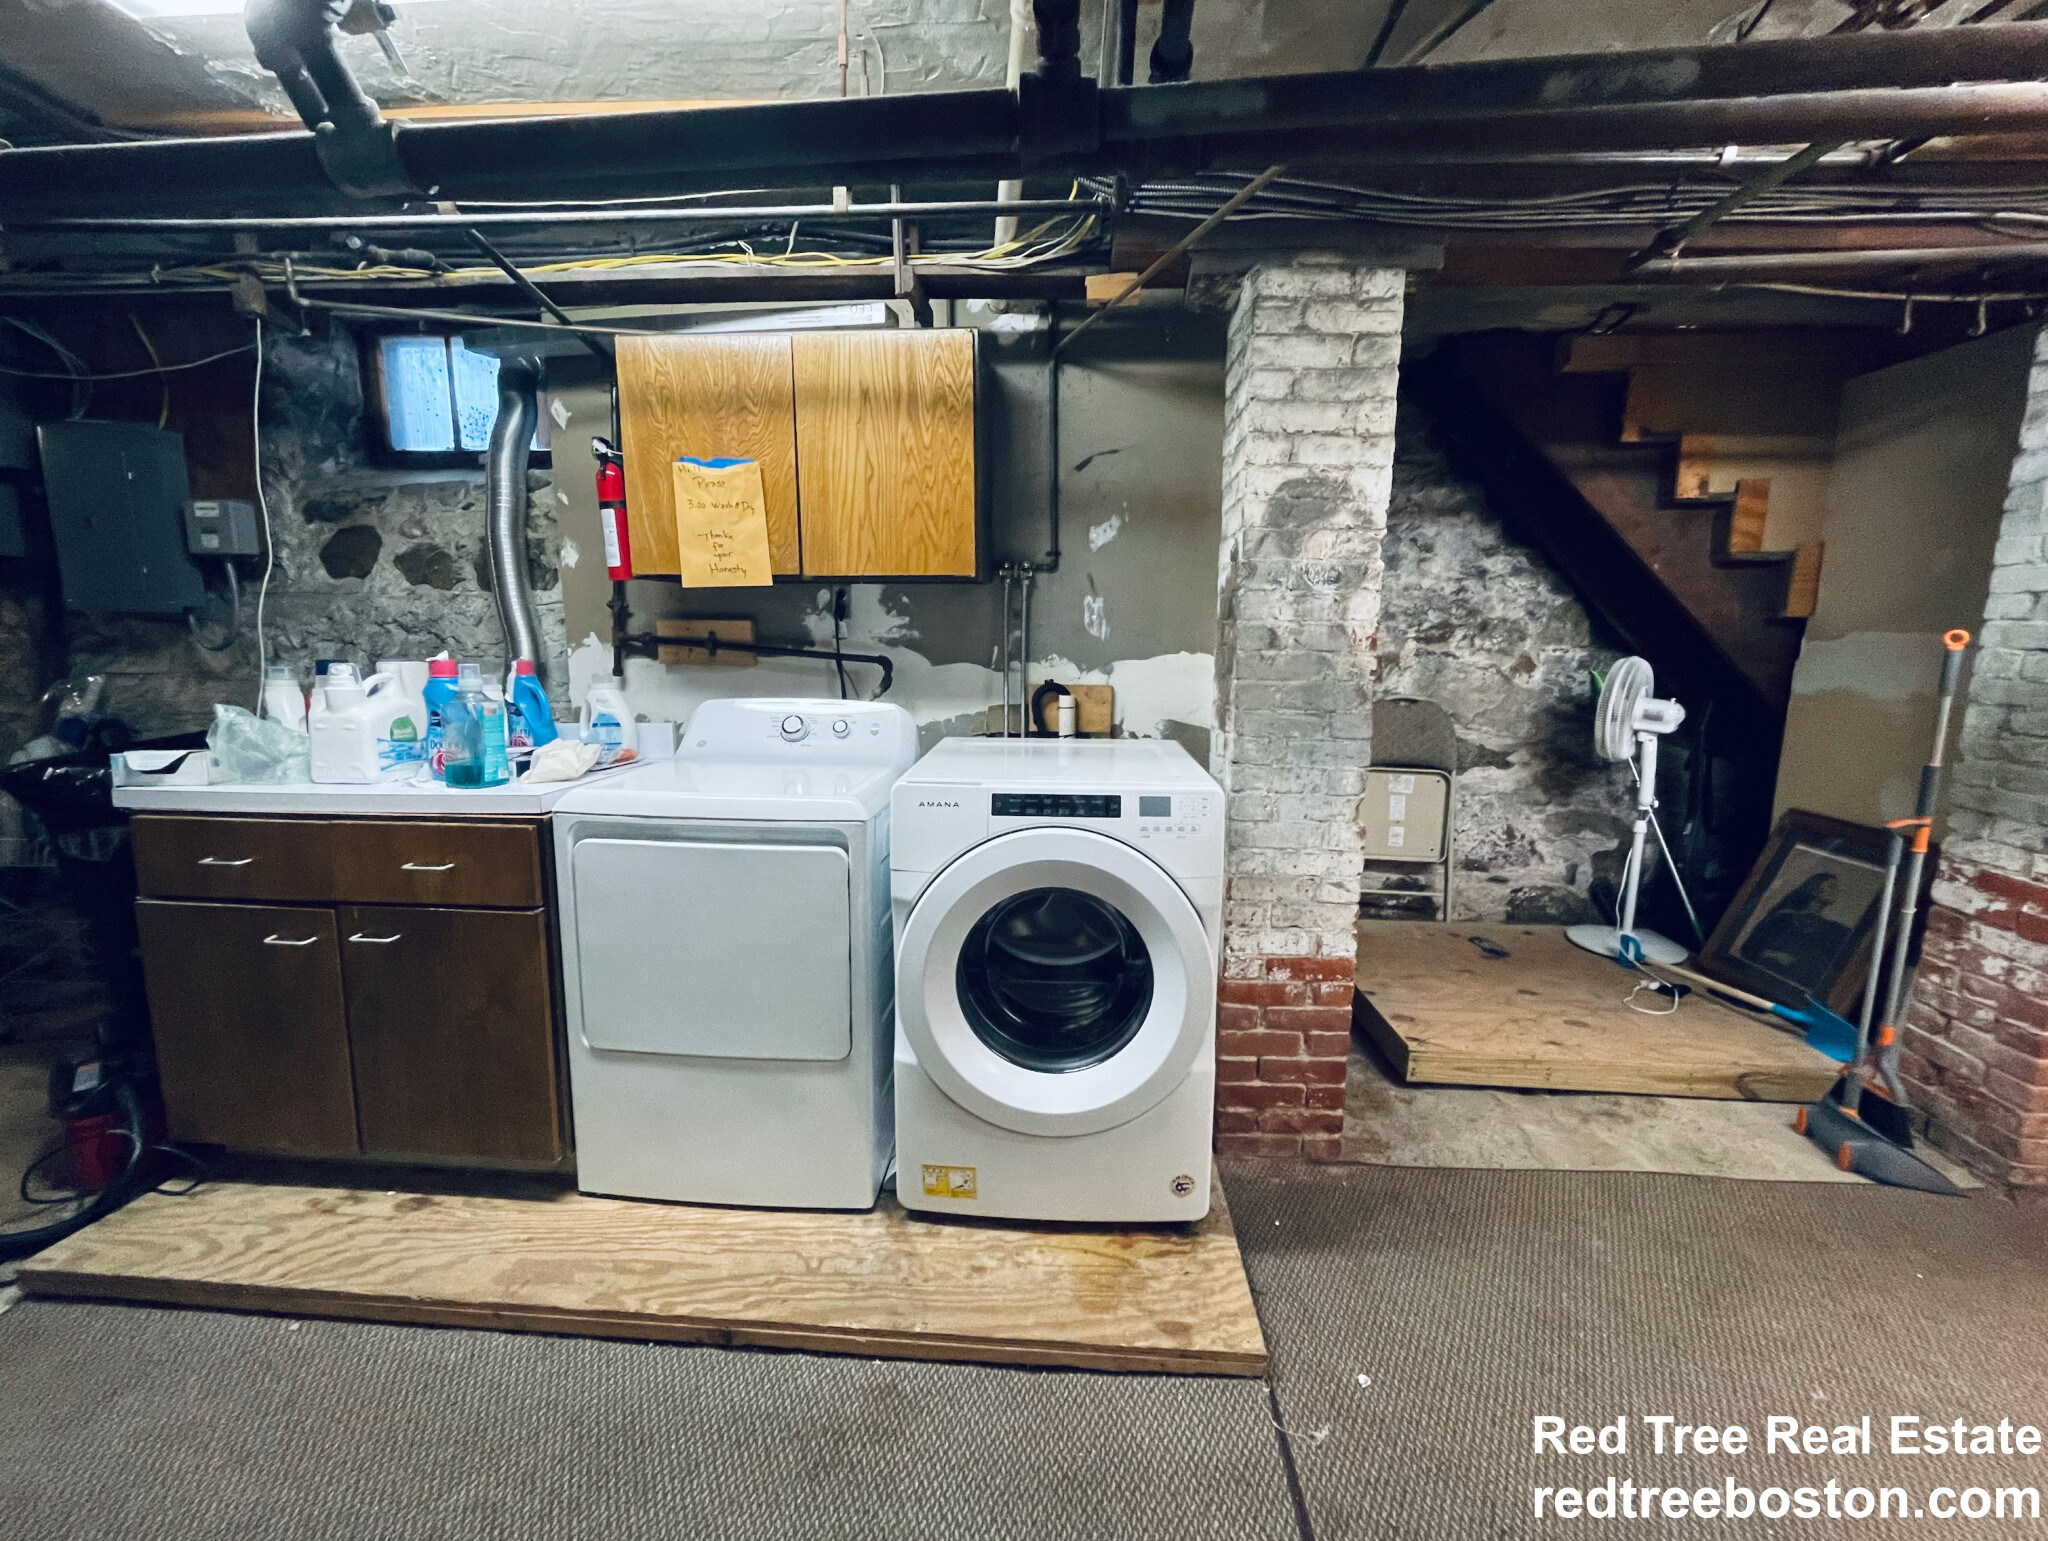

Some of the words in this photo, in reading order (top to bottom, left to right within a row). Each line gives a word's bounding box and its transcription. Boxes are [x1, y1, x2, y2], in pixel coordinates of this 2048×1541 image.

[697, 529, 734, 541] Thanks
[712, 541, 724, 551] for
[713, 551, 734, 562] your
[709, 562, 747, 578] Honesty
